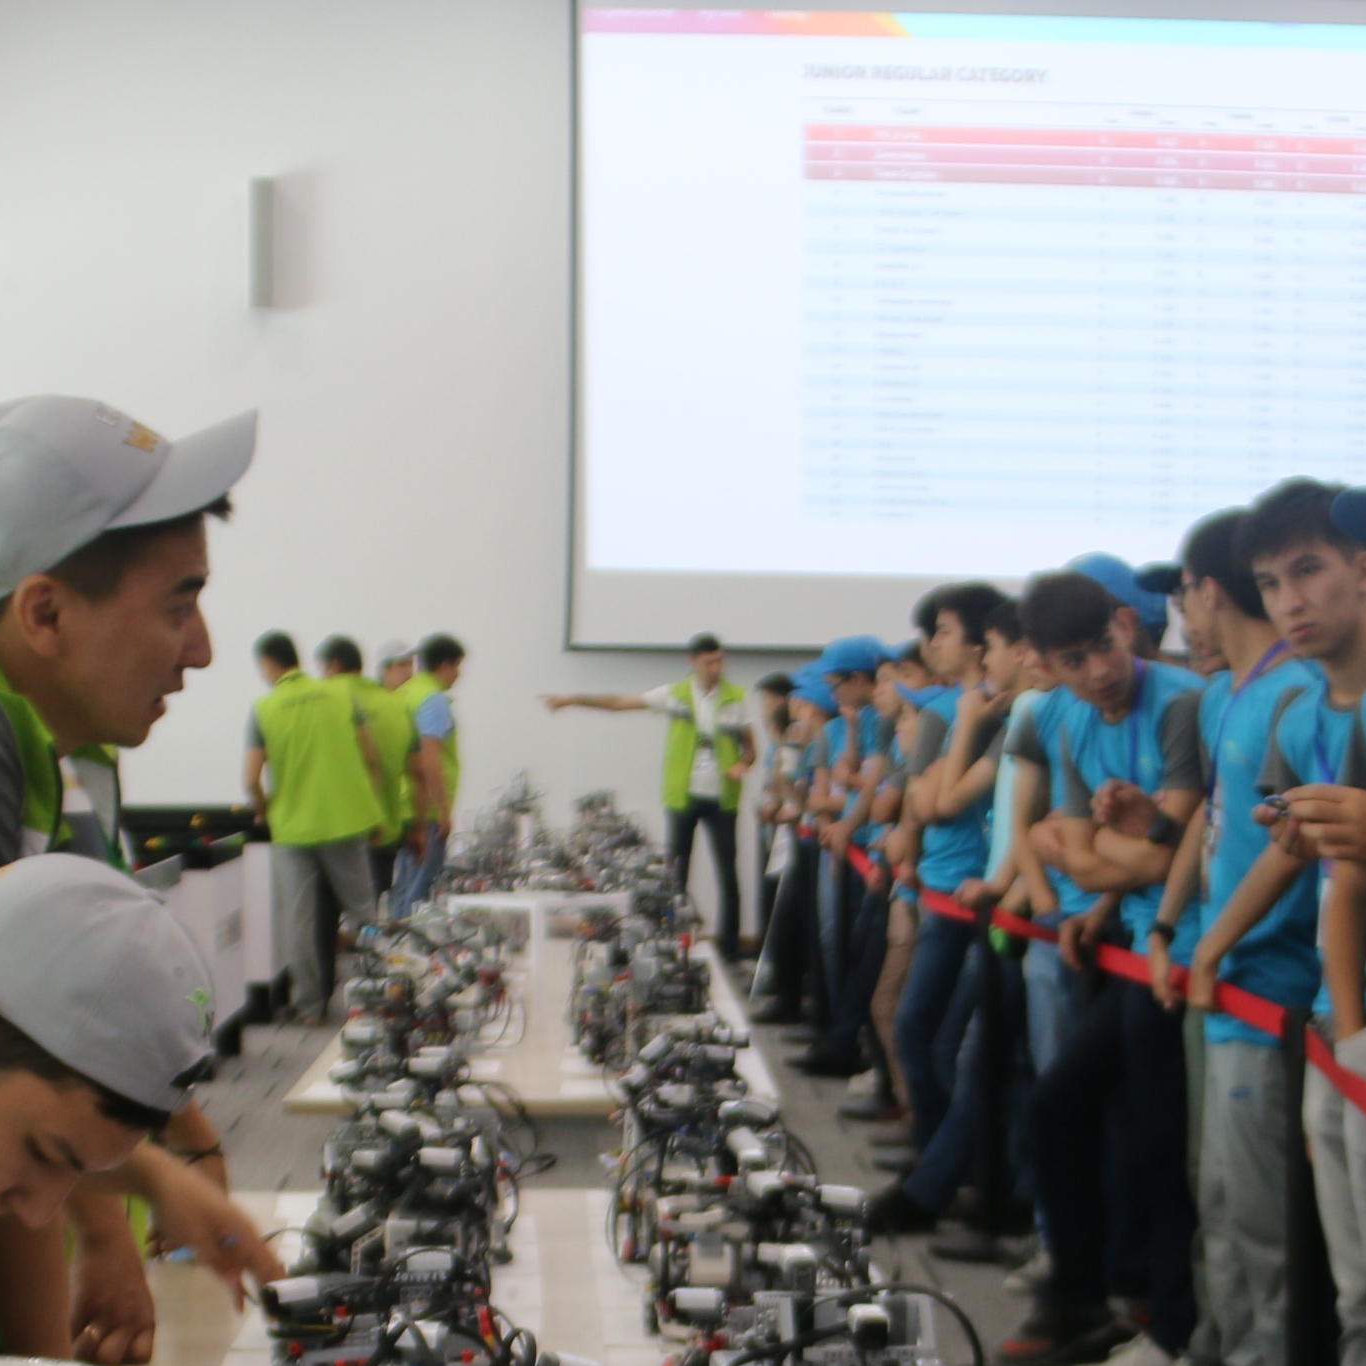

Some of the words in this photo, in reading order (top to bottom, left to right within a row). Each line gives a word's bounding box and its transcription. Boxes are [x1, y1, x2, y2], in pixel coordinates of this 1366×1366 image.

[802, 64, 867, 80] JUNIOR
[871, 65, 952, 82] REGULAR
[955, 67, 1047, 84] CATEGORY
